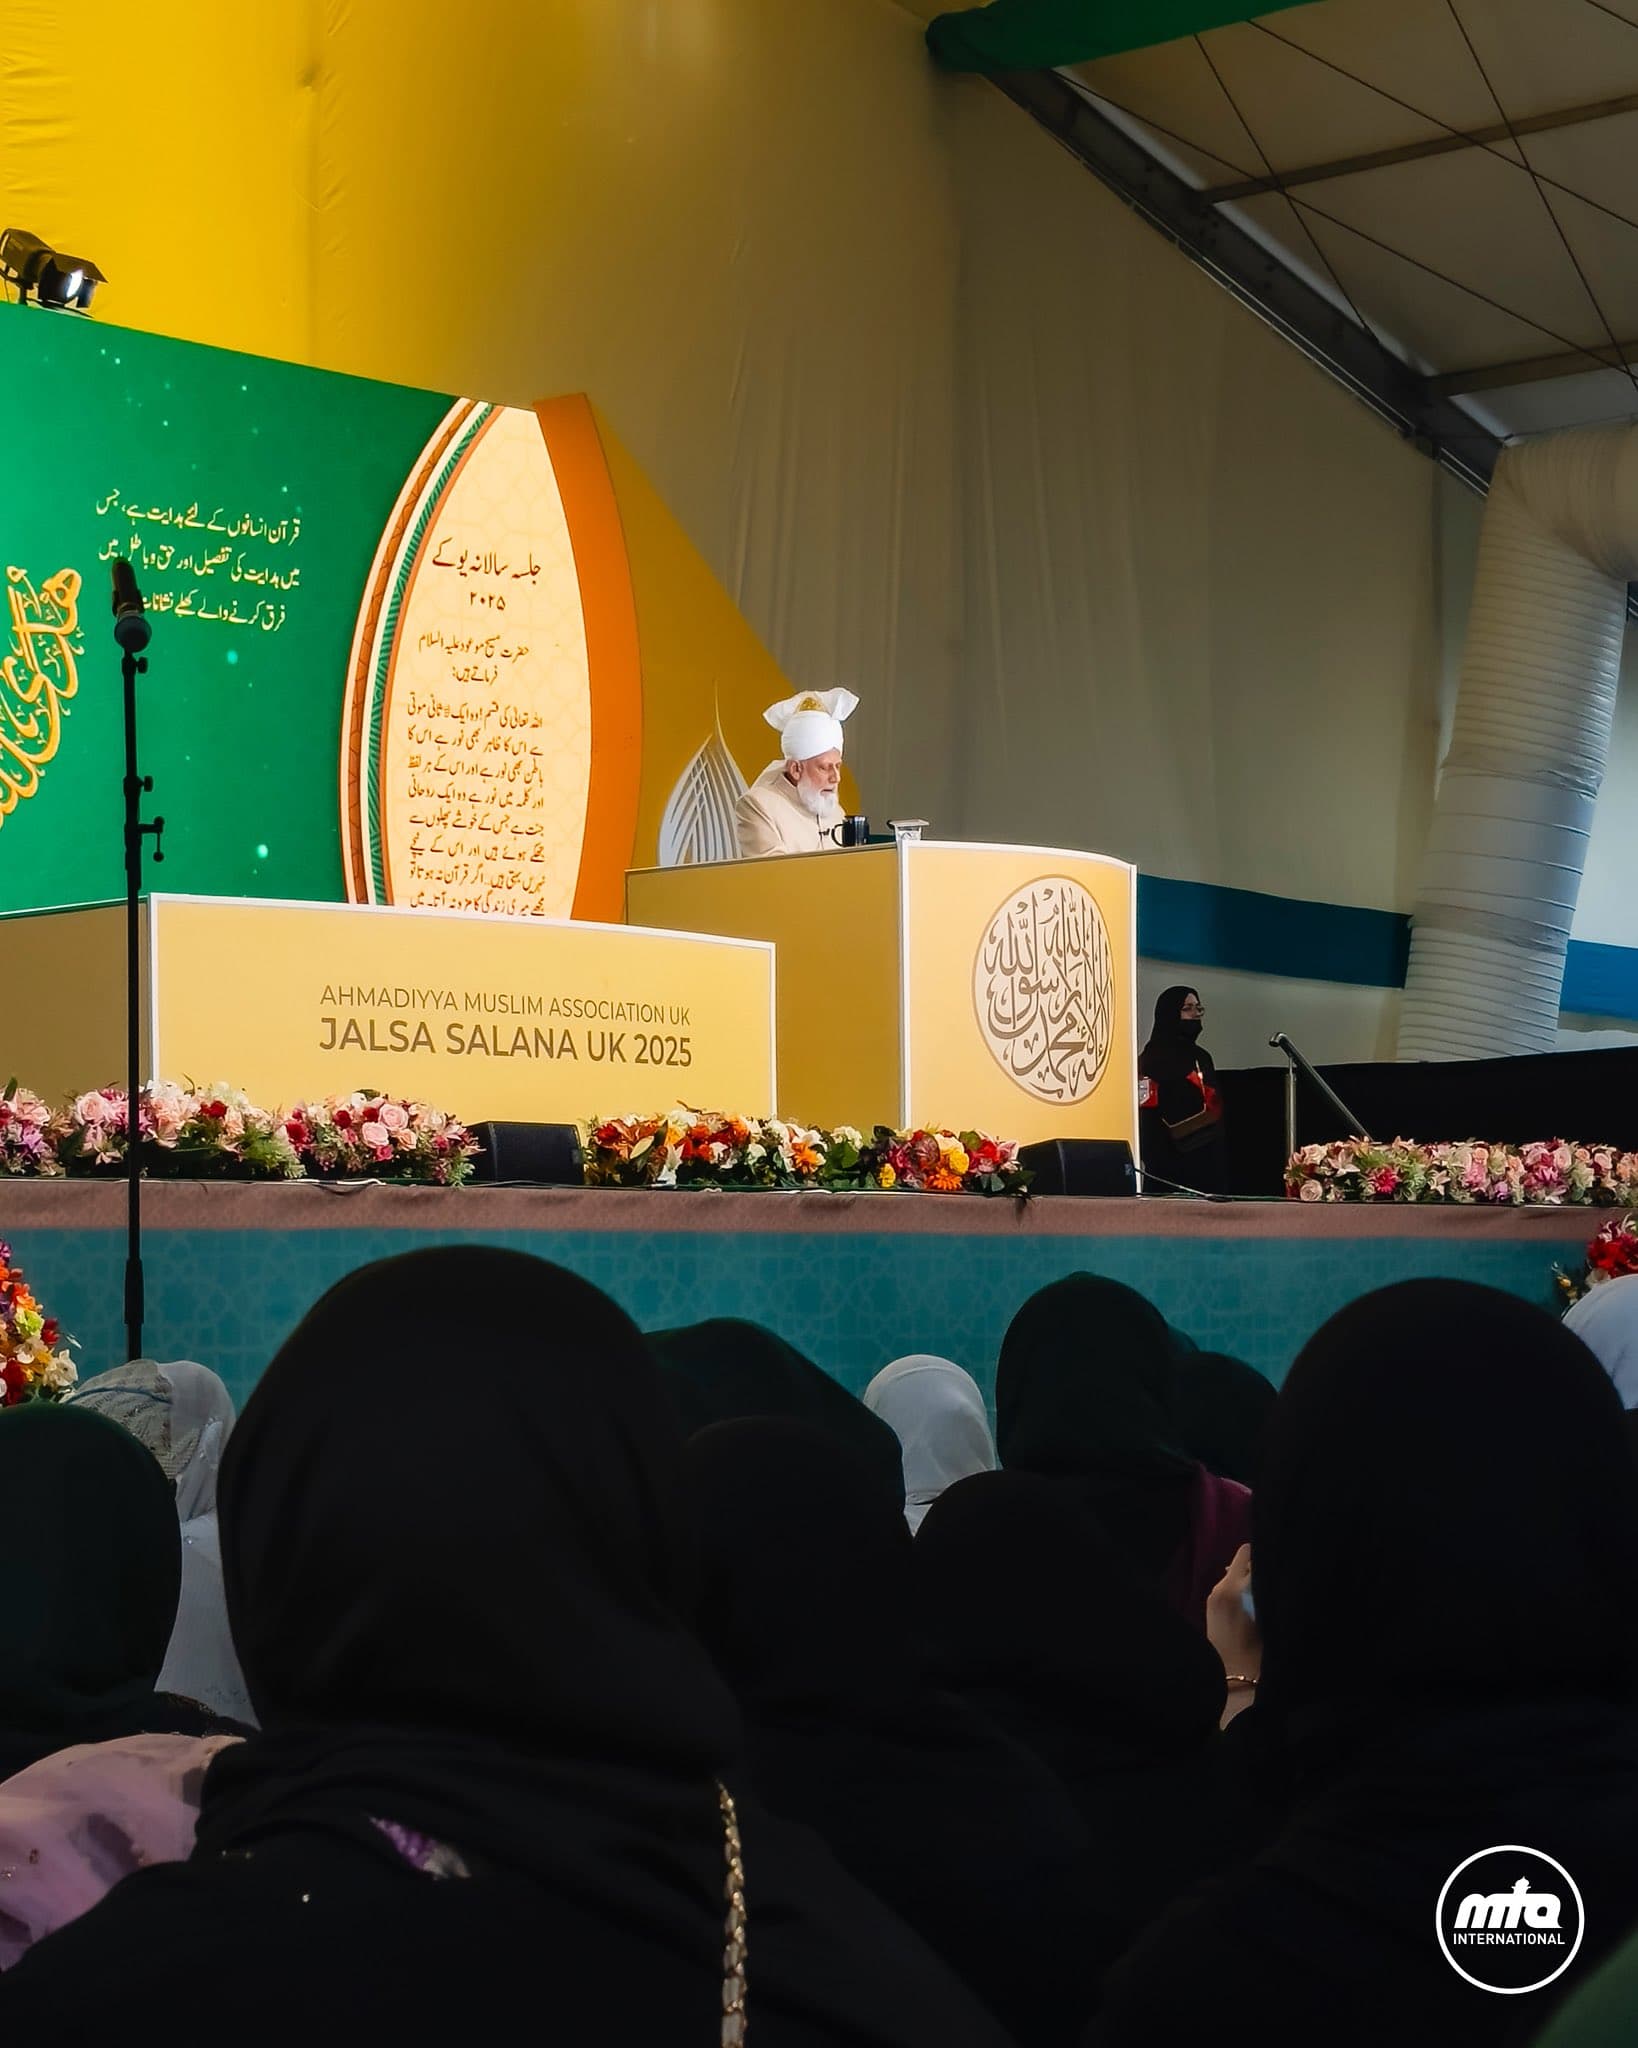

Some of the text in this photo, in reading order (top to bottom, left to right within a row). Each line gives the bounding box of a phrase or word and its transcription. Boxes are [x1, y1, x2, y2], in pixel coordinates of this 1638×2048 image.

[96, 488, 120, 515] جس
[146, 507, 184, 529] ہدایت
[207, 508, 226, 531] کے
[227, 513, 267, 537] انسانوں
[268, 517, 300, 546] قرآن
[176, 555, 193, 570] اور
[194, 546, 233, 577] تفصیل
[231, 552, 246, 582] کی
[469, 551, 509, 577] سالانہ
[511, 552, 541, 585] جلسہ
[244, 568, 280, 590] ہدایت
[280, 568, 300, 590] میں
[261, 604, 286, 632] فرق
[320, 985, 691, 1026] AHMADIYYA MUSLIM ASSOCIATION UK
[319, 1017, 692, 1067] JALSA SALANA UK 2025
